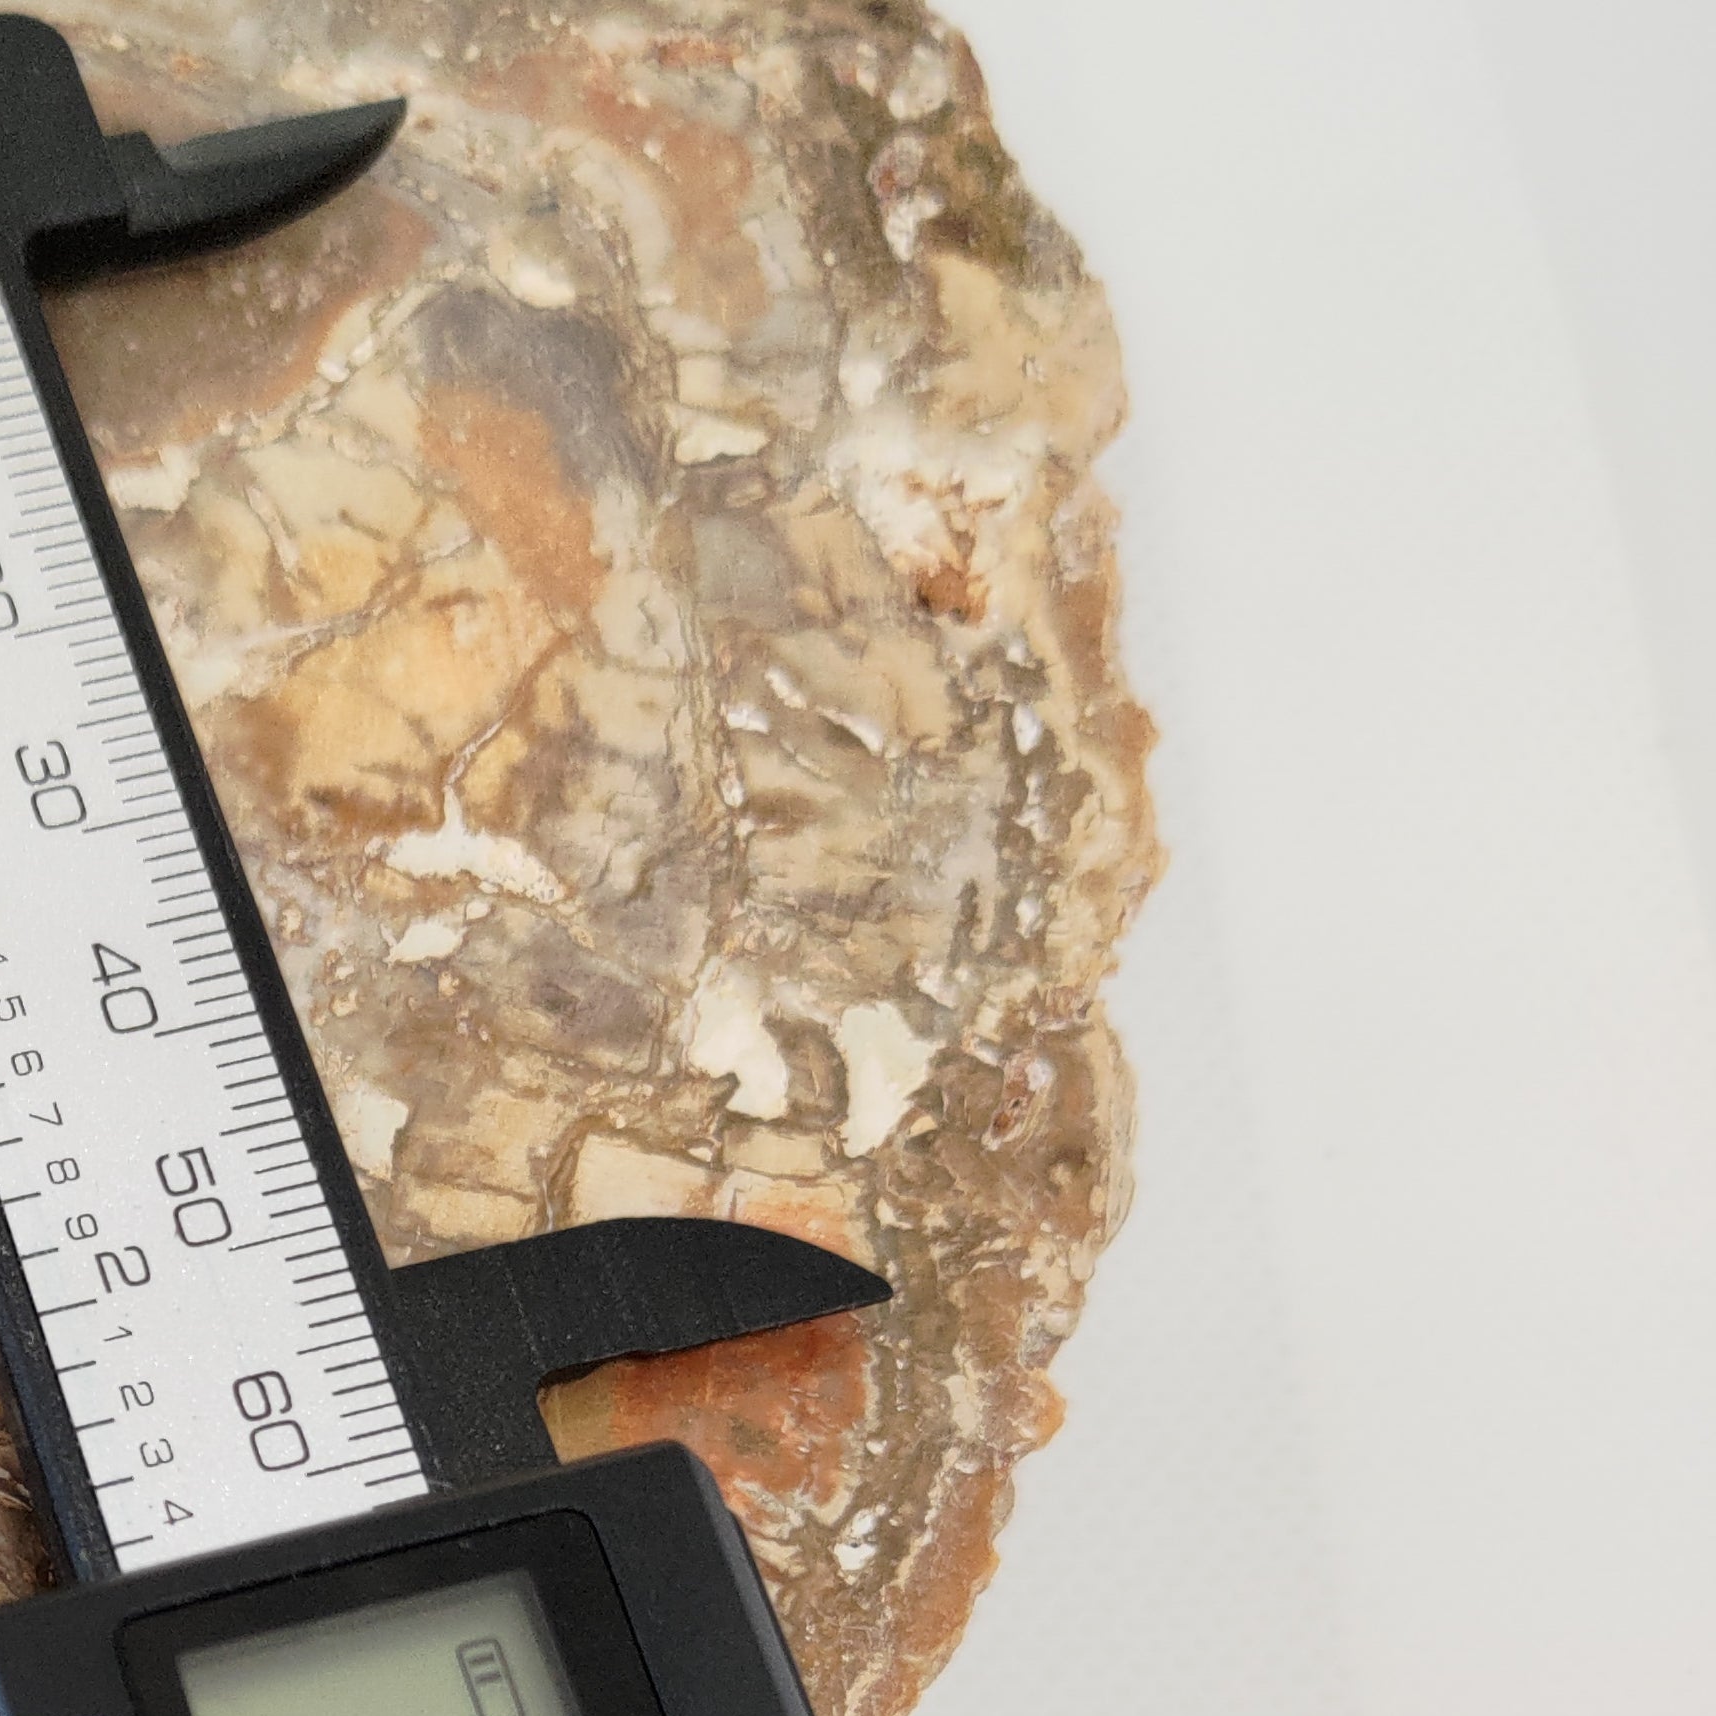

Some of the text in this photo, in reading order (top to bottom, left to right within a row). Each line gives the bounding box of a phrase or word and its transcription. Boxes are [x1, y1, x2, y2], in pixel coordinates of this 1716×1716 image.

[11, 1050, 44, 1076] 6
[15, 740, 86, 830] 30
[92, 943, 159, 1034] 40
[155, 1147, 232, 1247] 50
[233, 1371, 310, 1471] 60
[29, 1102, 63, 1126] 7
[47, 1158, 80, 1184] 8
[65, 1214, 98, 1240] 9
[95, 1246, 150, 1293] 2
[104, 1326, 132, 1341] 1
[119, 1381, 154, 1411] 2
[140, 1438, 174, 1467] 3
[164, 1500, 193, 1525] 4
